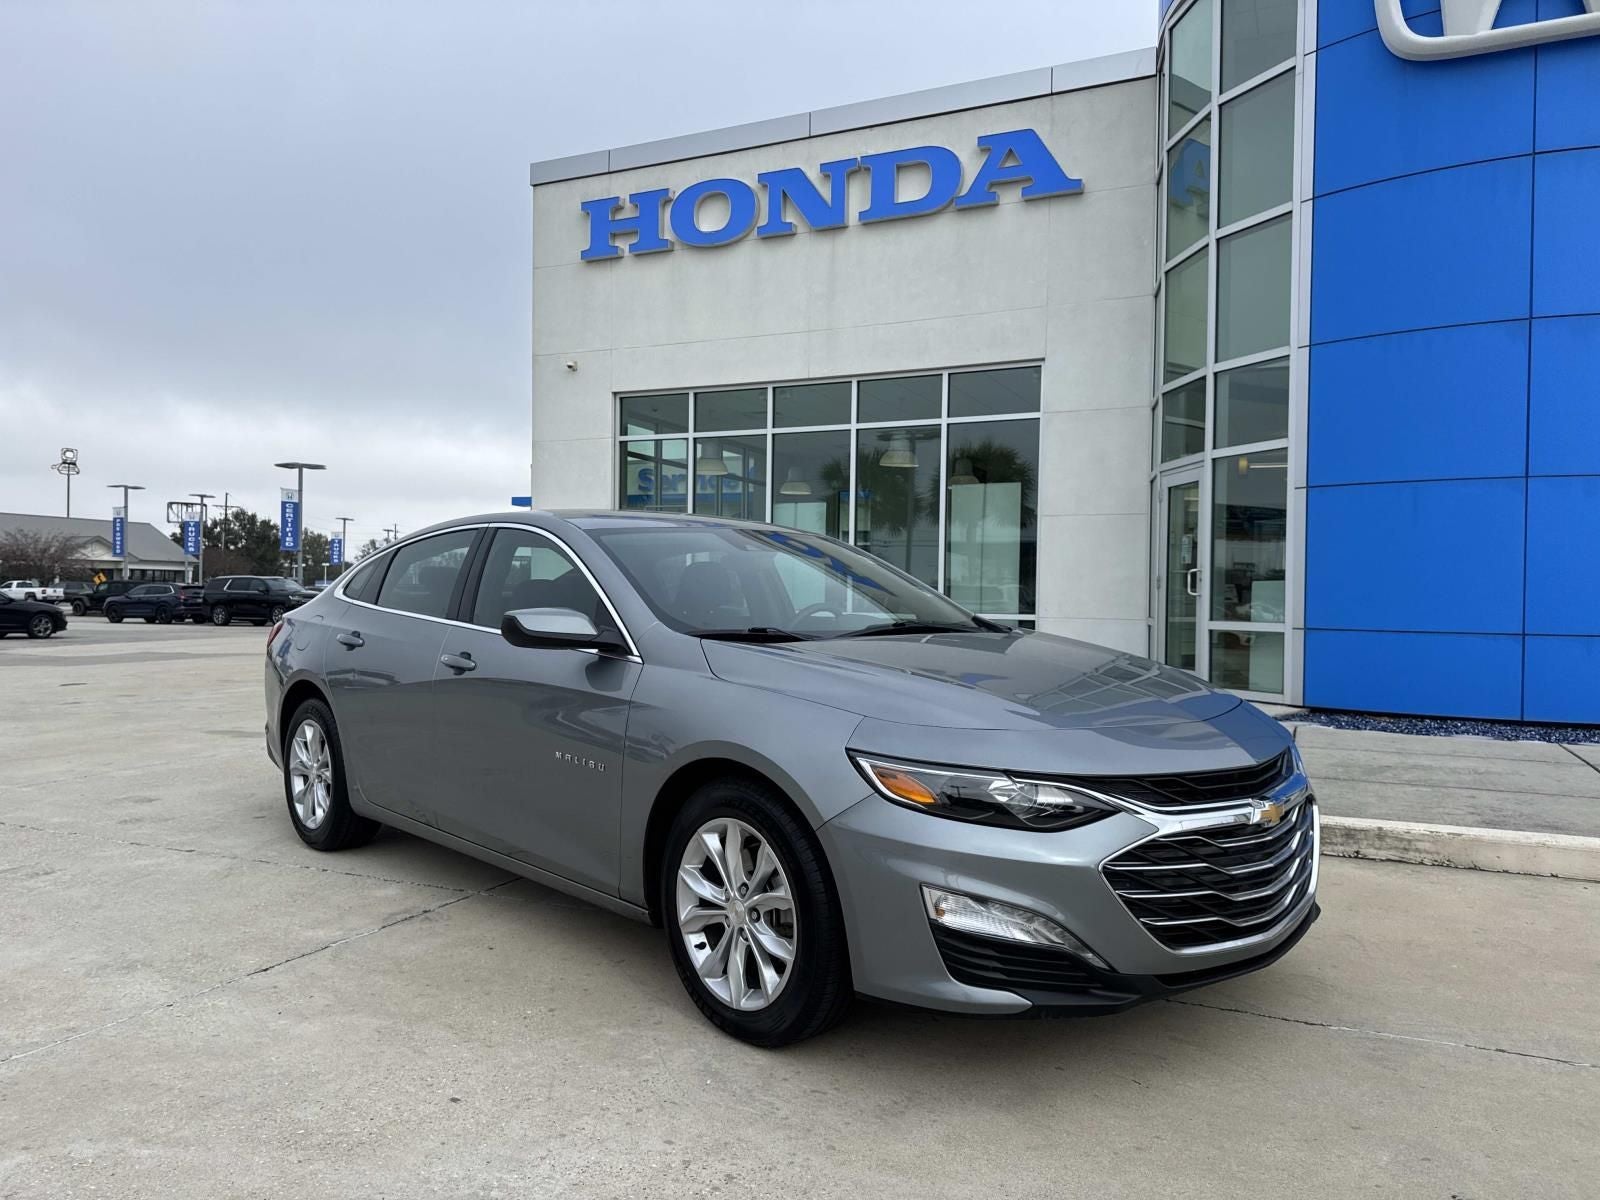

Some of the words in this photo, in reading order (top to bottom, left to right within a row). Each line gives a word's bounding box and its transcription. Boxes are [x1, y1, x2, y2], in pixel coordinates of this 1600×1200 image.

[580, 128, 1084, 262] HONDA
[187, 521, 196, 552] TRUCKS
[285, 503, 294, 547] CERTIFIED
[555, 751, 605, 772] MALIBU
